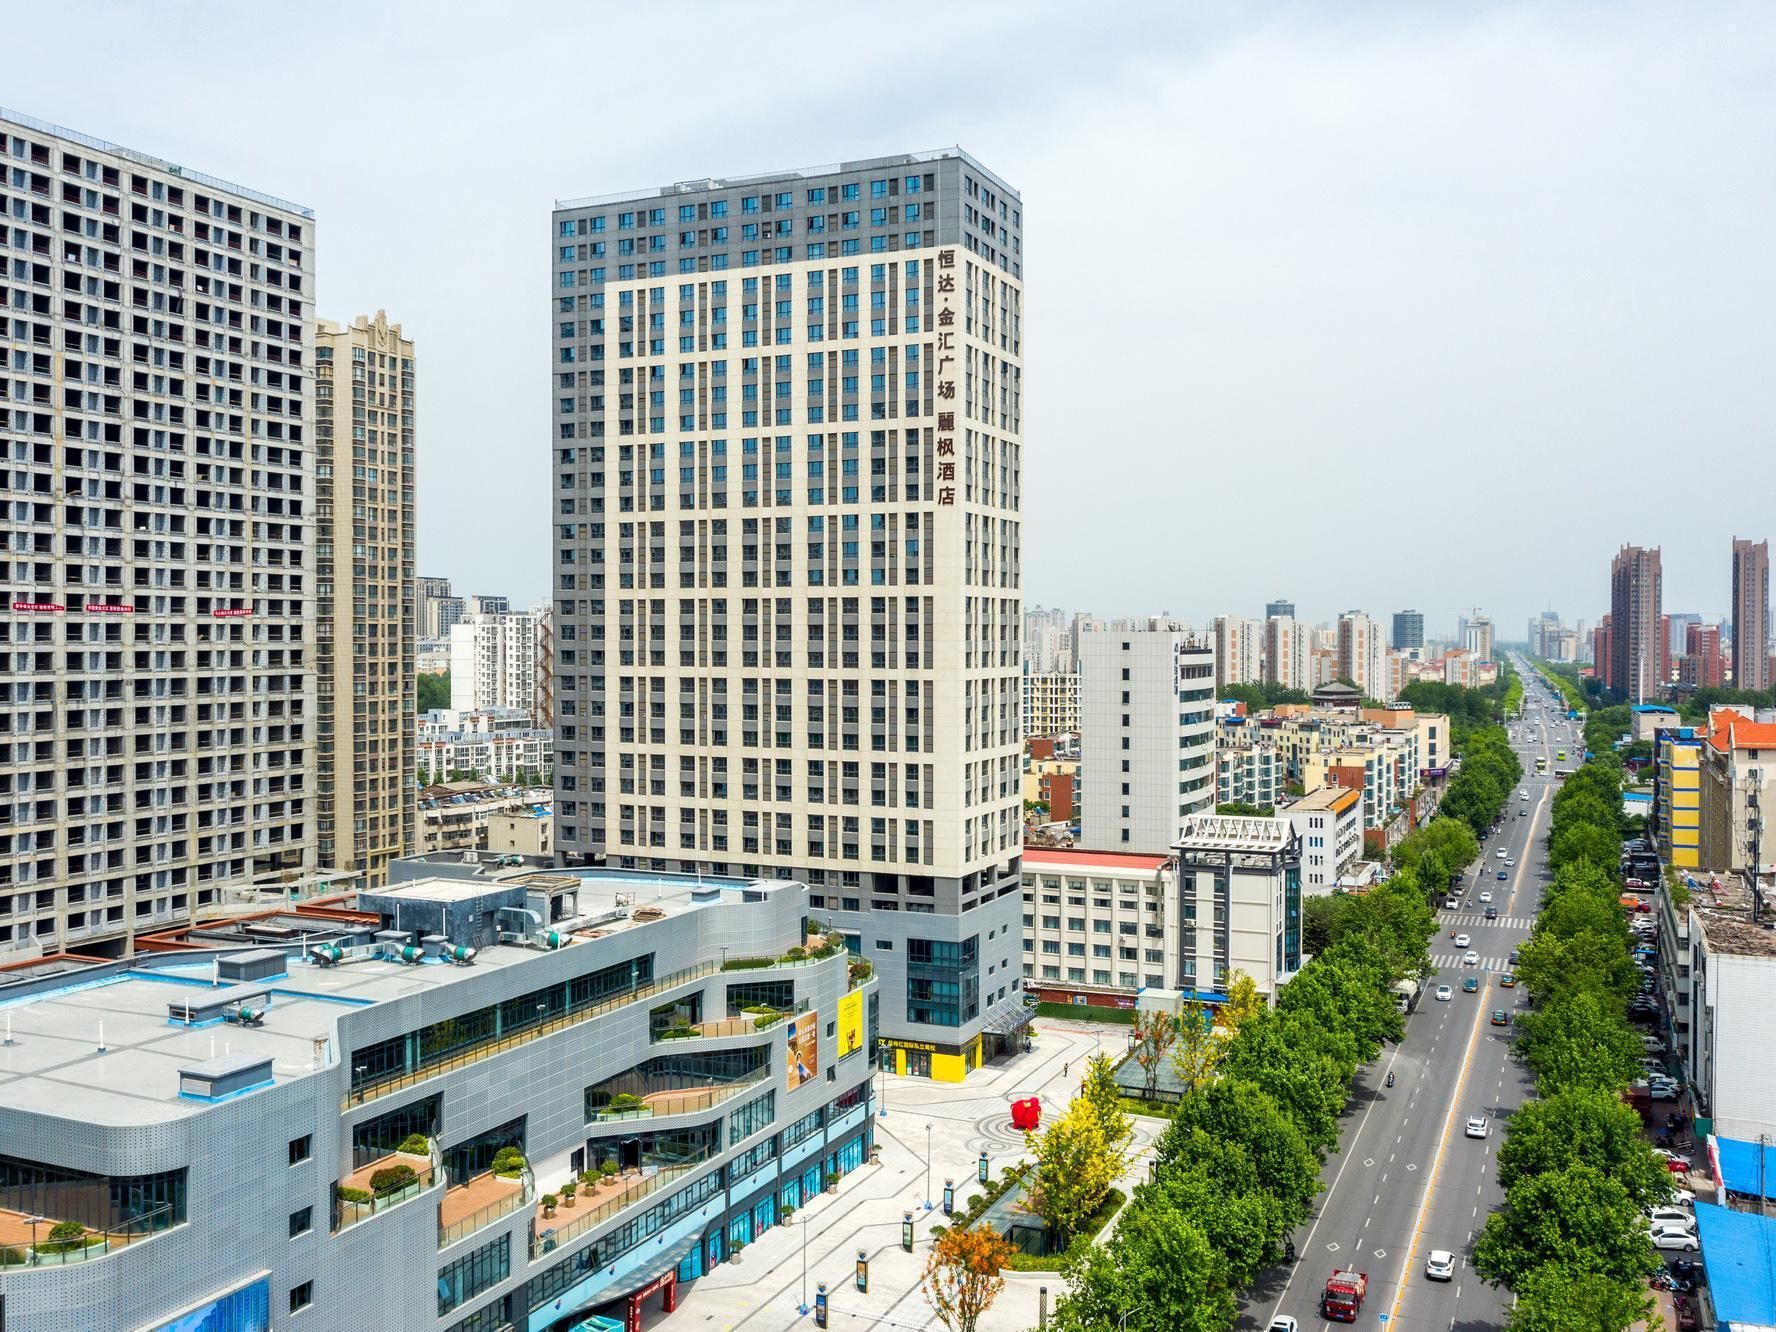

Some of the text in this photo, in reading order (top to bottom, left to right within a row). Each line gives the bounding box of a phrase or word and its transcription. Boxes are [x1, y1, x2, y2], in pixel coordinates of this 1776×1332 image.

[937, 249, 956, 506] 恒达·金汇广场 麗枫酒店
